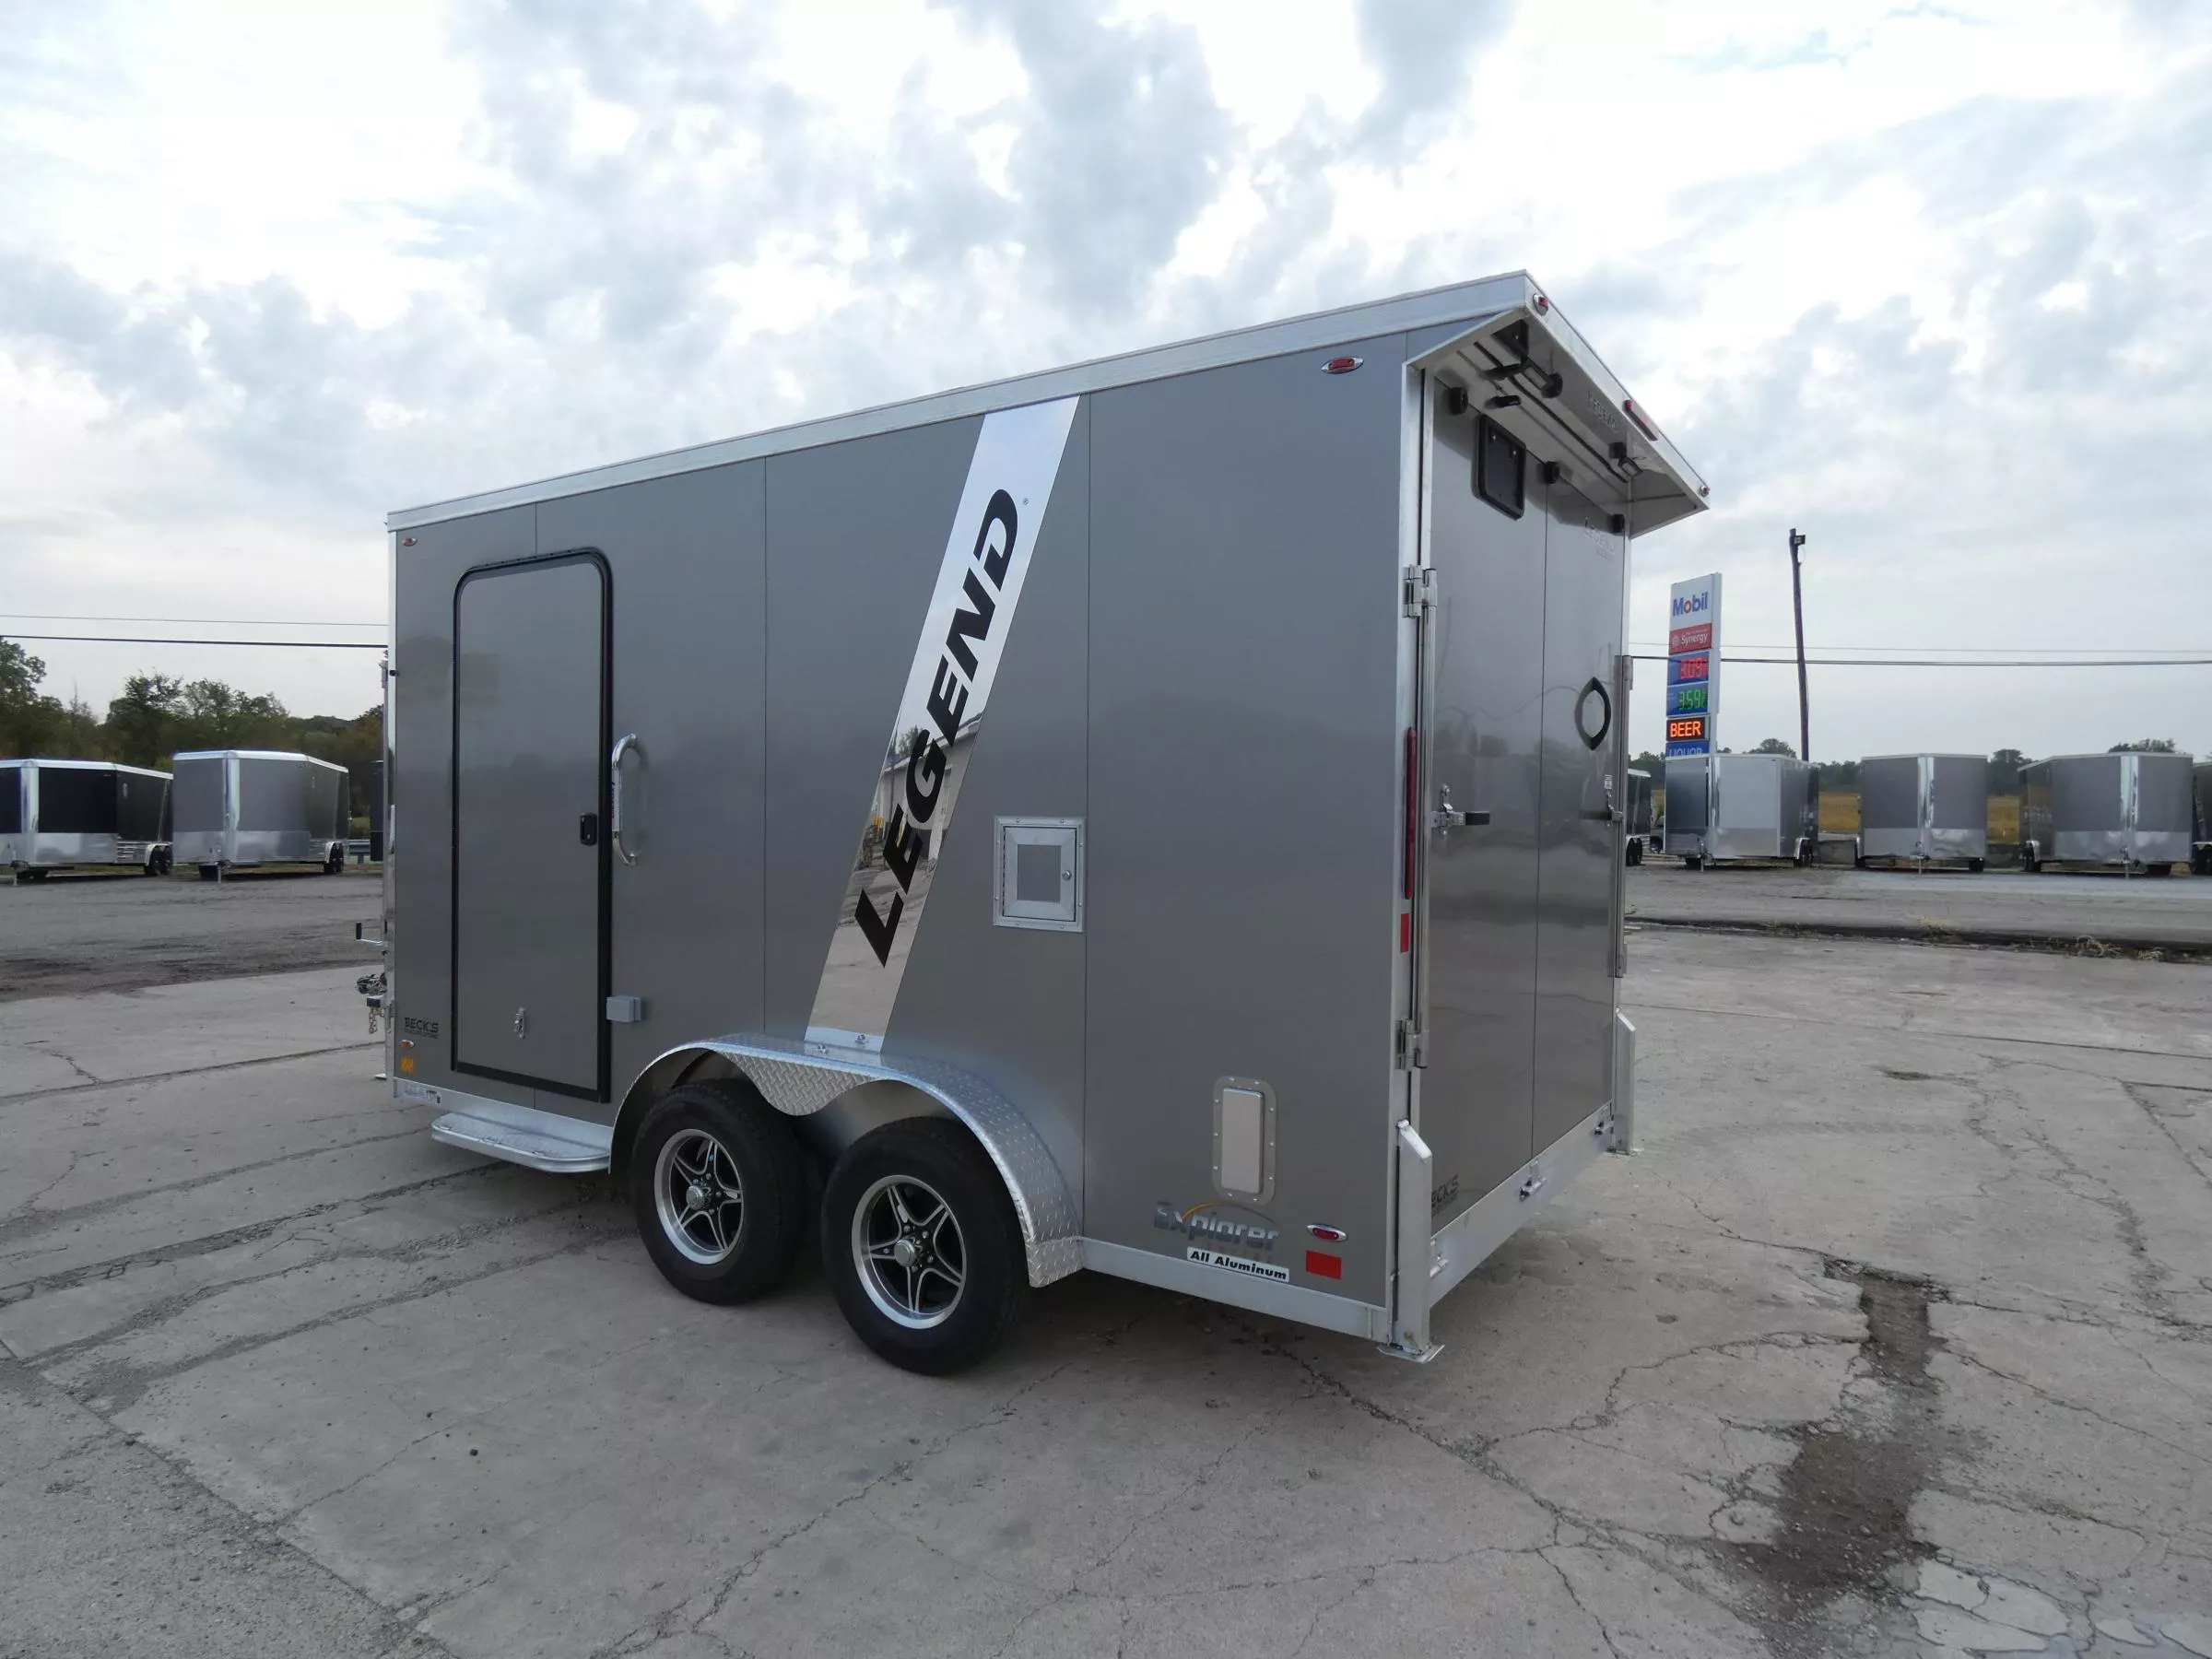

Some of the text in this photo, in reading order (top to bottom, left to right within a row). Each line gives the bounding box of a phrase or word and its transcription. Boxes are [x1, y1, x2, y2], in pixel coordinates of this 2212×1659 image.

[1672, 591, 1709, 617] Mobil
[1680, 633, 1708, 647] Synergy
[853, 488, 1018, 969] LEGEND
[1670, 721, 1701, 738] BEER
[1190, 1251, 1210, 1263] All
[1215, 1255, 1287, 1280] Aluminum
